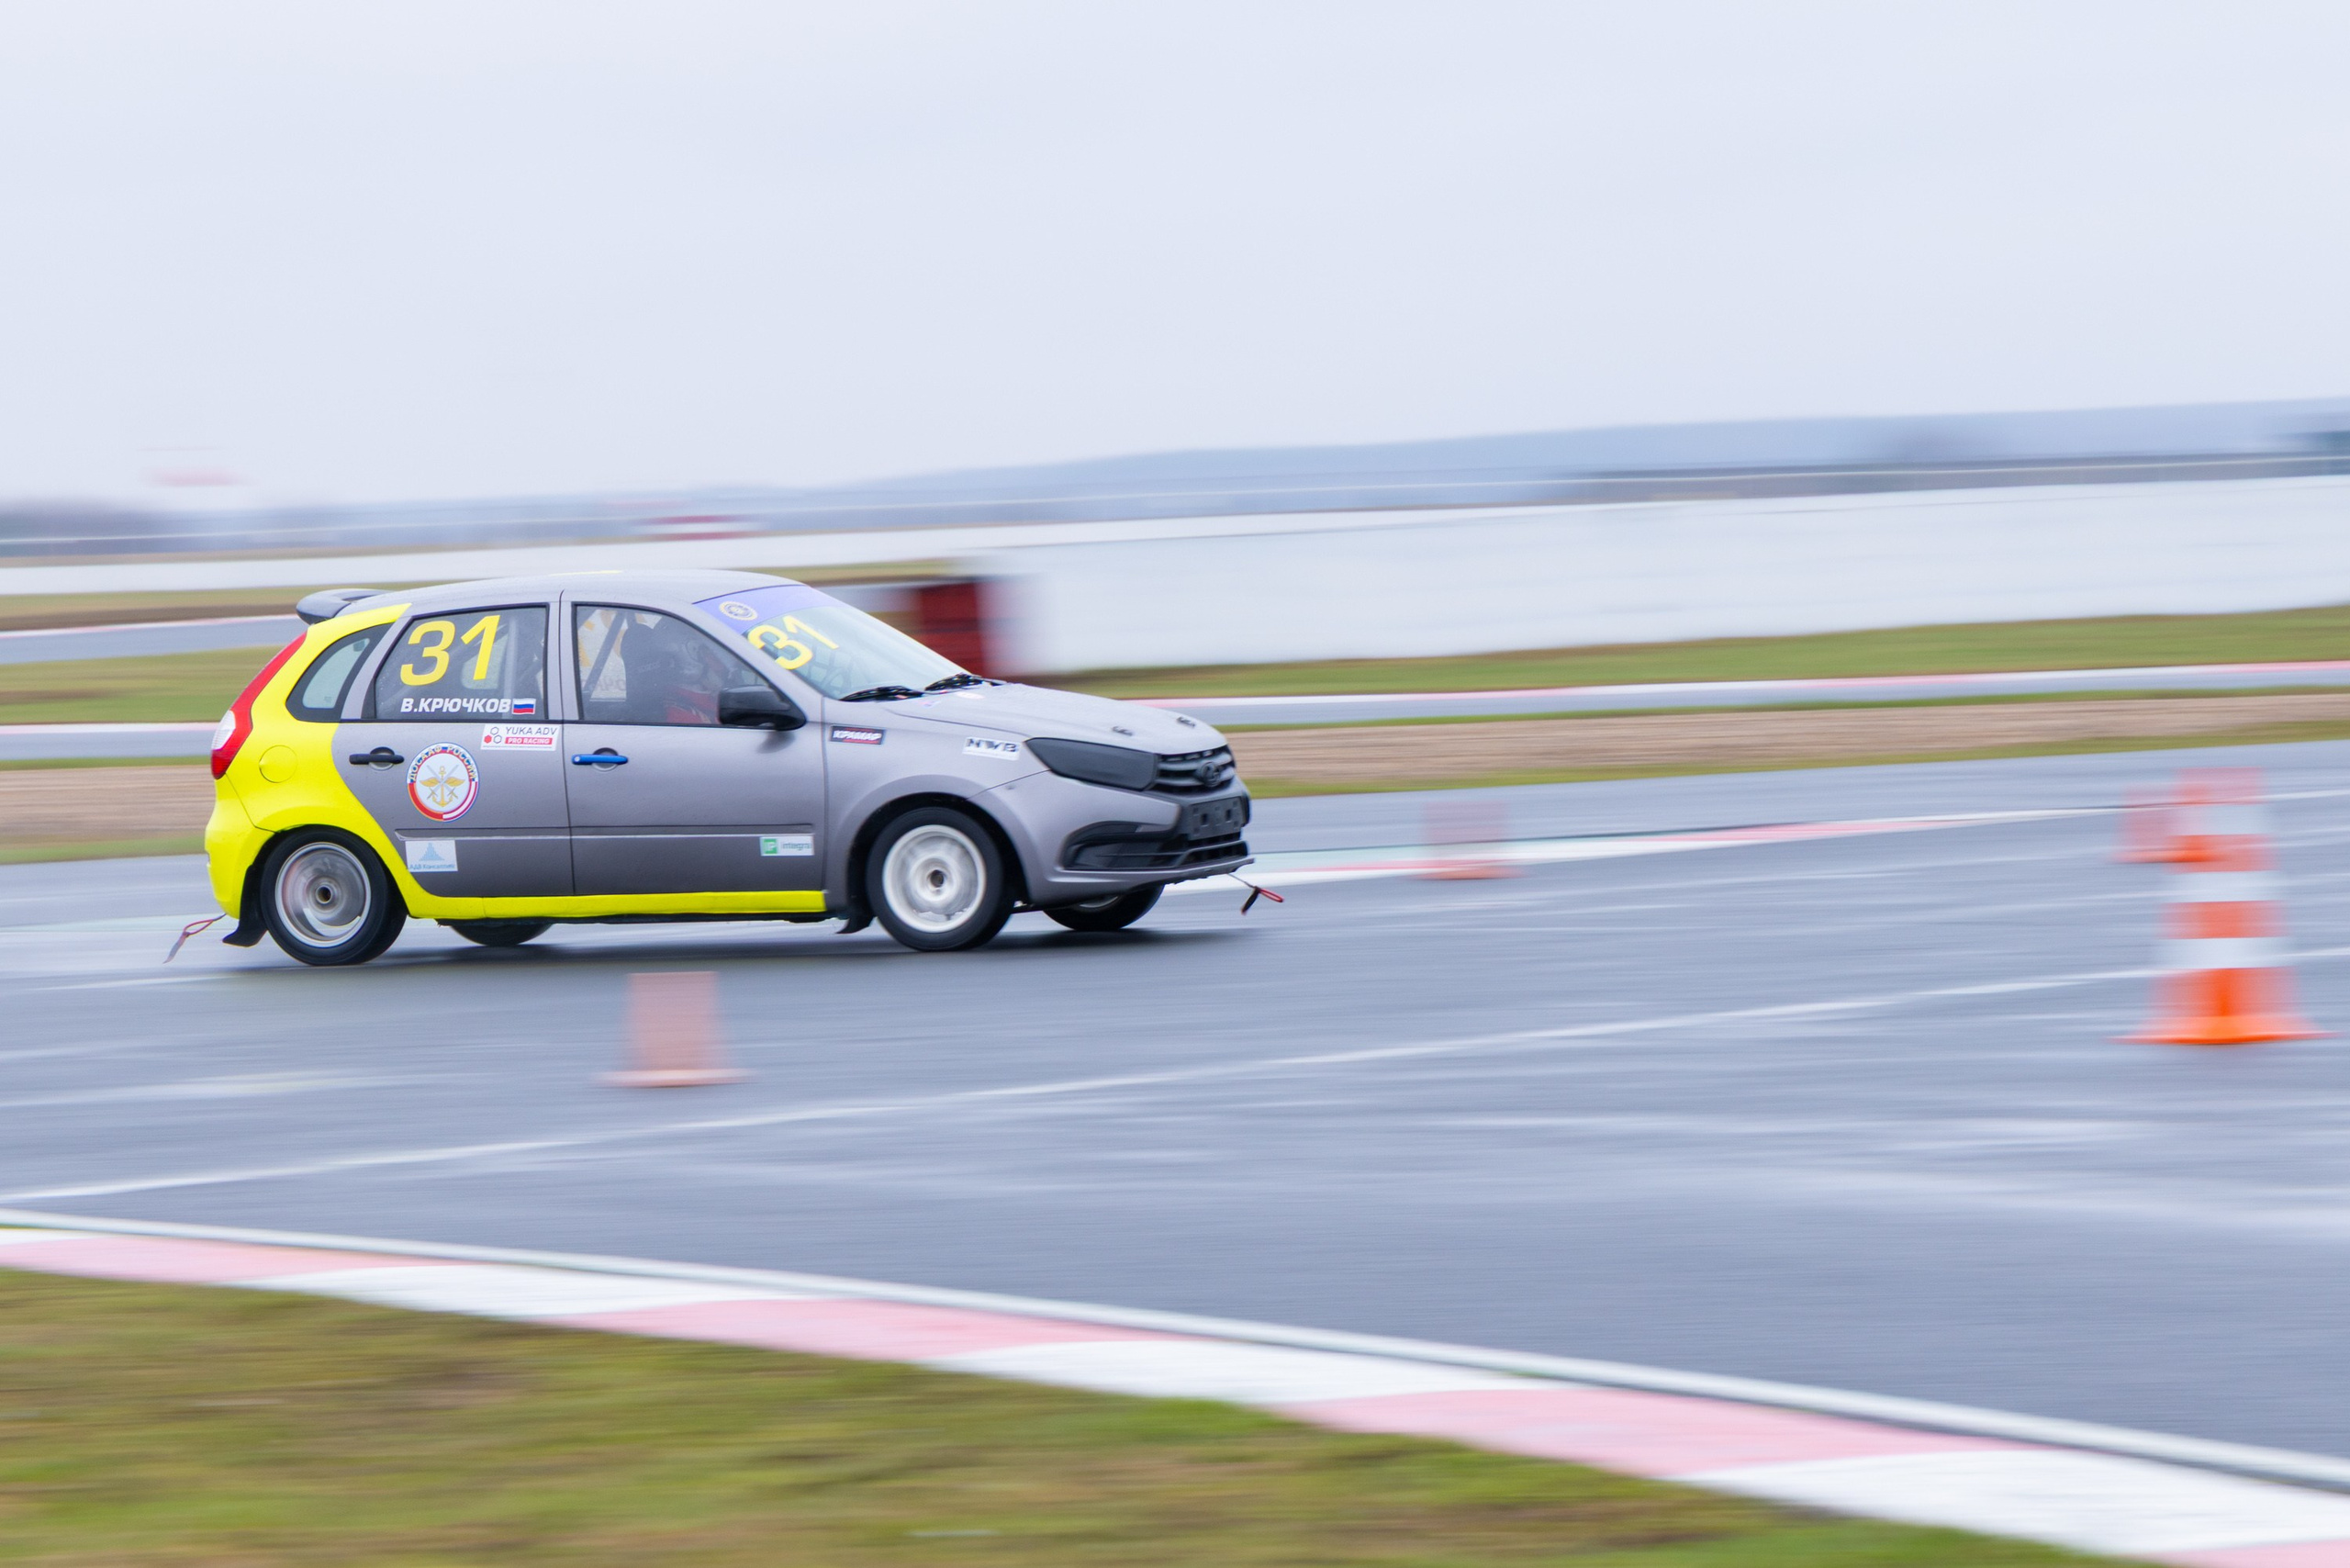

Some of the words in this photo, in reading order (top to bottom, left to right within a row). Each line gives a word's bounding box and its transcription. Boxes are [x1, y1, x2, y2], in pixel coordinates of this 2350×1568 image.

[400, 614, 500, 686] 31
[747, 614, 840, 670] 31
[400, 698, 511, 713] В.КРЮЧКОВ
[505, 726, 532, 735] YUKA
[534, 727, 557, 735] ADV
